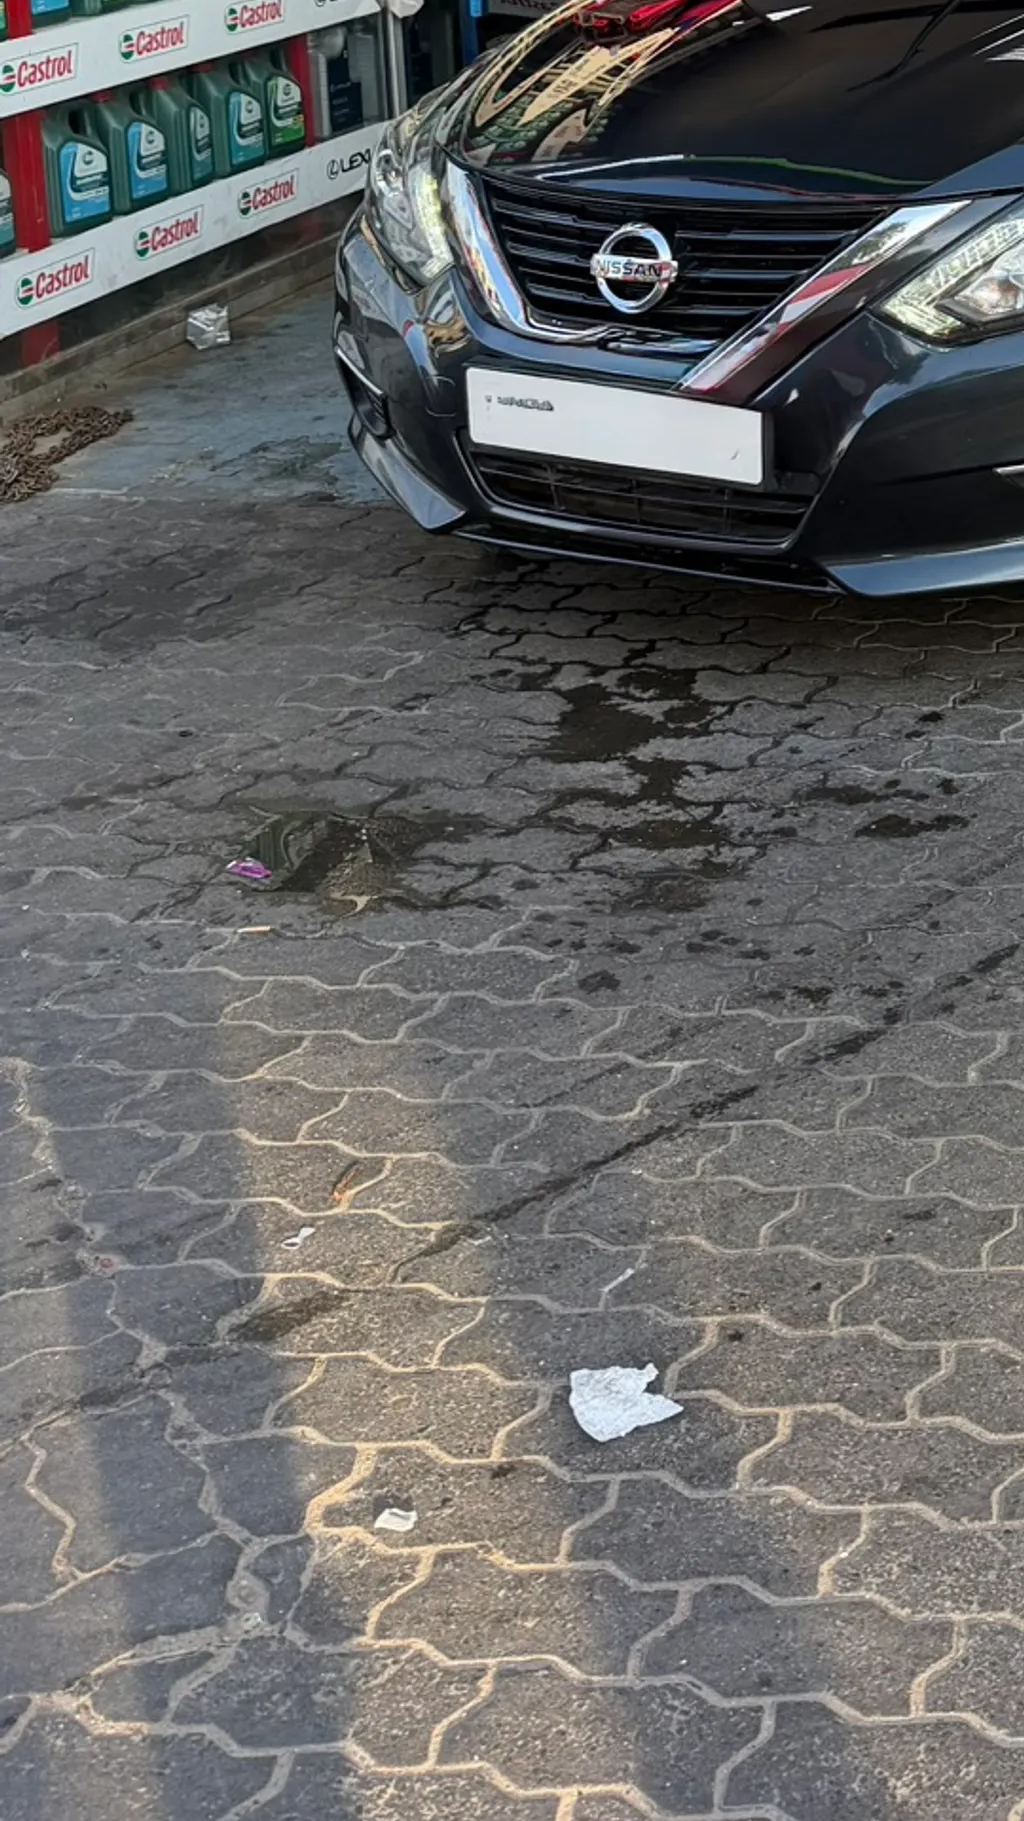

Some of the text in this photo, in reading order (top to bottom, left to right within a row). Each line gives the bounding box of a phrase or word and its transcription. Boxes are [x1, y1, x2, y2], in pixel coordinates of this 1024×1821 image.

[17, 54, 73, 87] Castrol
[136, 21, 185, 56] Castrol
[36, 148, 371, 298] Castrol Castrol Castrol LEX
[598, 259, 662, 277] NISSAN
